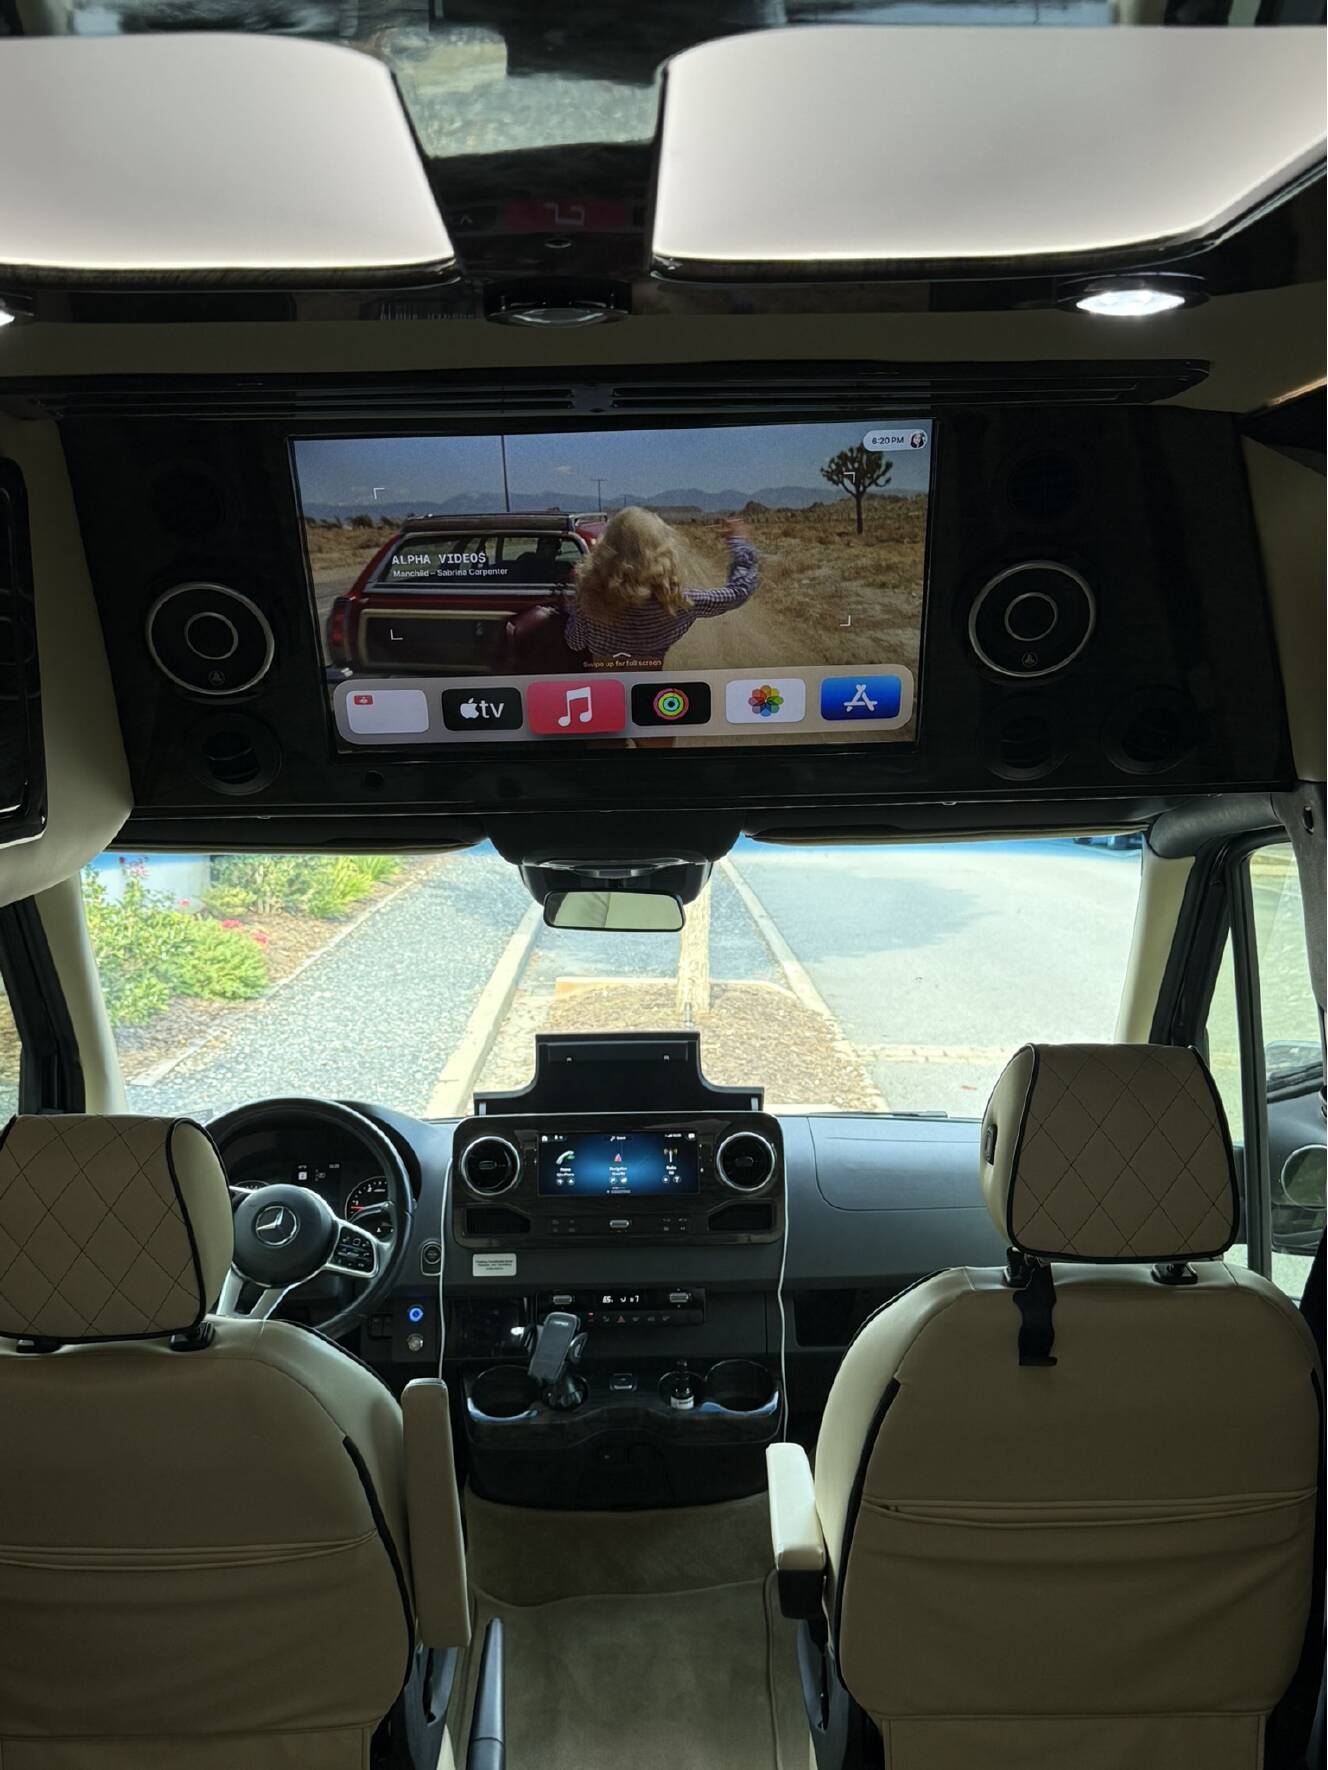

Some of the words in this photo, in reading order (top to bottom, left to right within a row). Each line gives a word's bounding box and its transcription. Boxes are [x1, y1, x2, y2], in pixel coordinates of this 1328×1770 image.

[871, 437, 890, 445] 6:20
[891, 436, 904, 444] PM
[392, 554, 431, 565] ALPHA
[438, 552, 486, 564] VIDEOS
[437, 568, 467, 577] Sabrina
[468, 568, 508, 576] Carpenter
